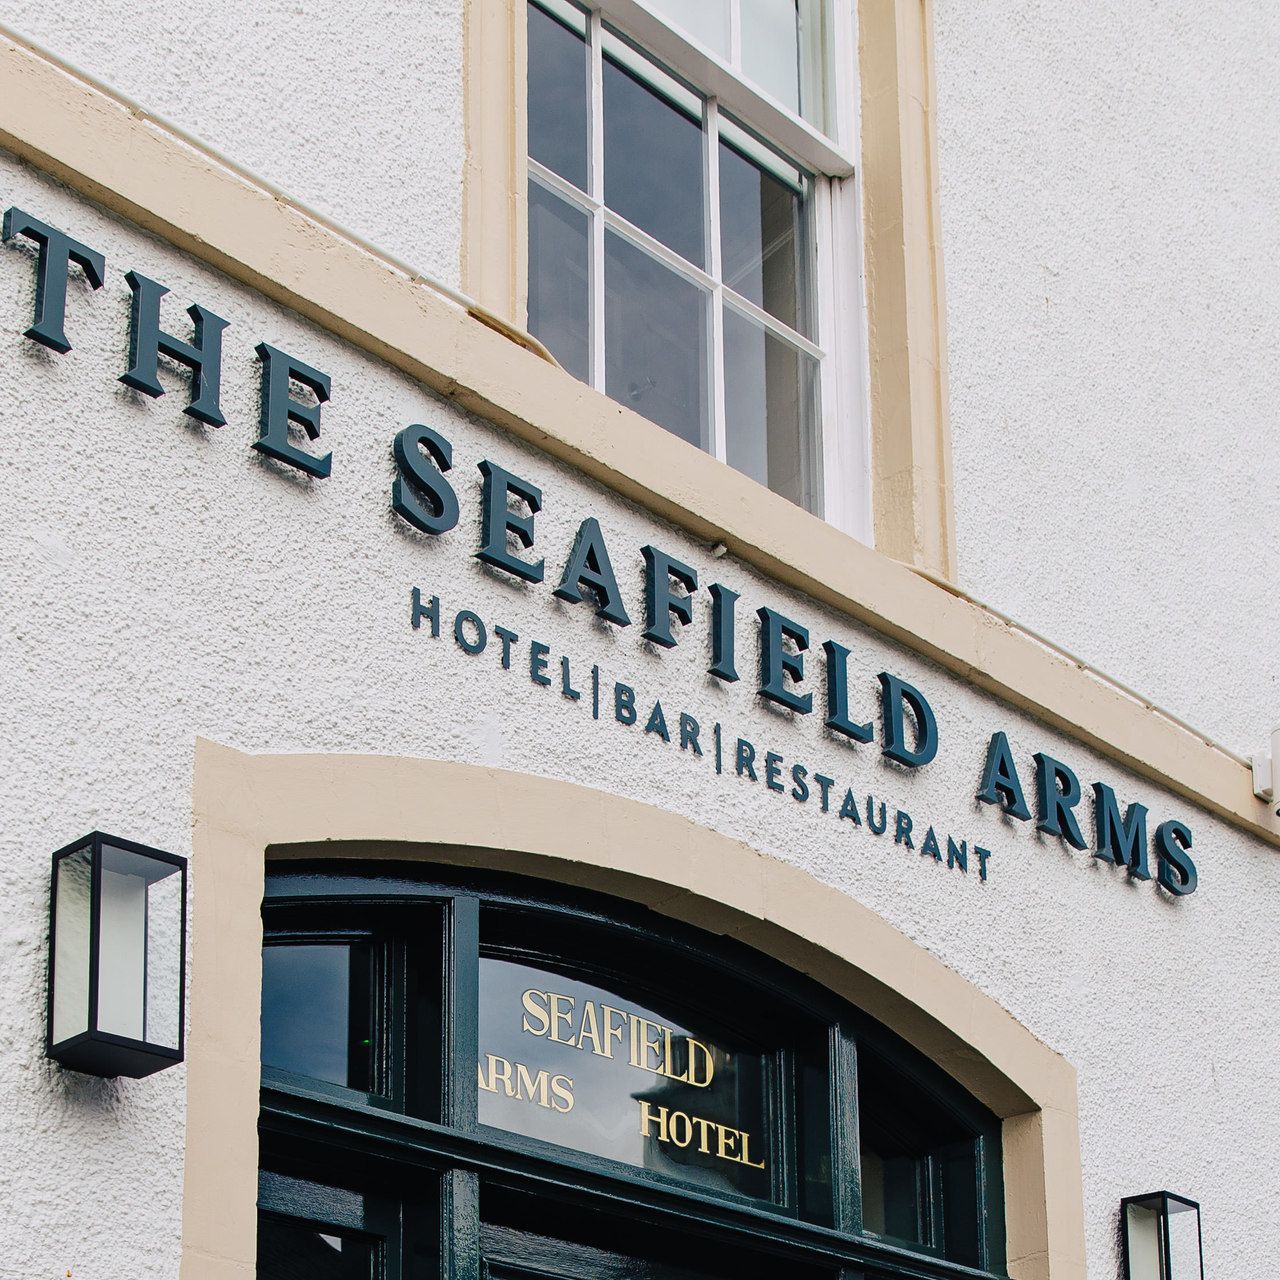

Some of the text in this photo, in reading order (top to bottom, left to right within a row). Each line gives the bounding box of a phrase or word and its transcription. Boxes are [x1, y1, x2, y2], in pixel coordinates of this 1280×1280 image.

[3, 206, 1198, 897] THE SEAFIELD ARMS
[411, 586, 992, 881] HOTEL BAR RESTAURANT
[521, 988, 715, 1088] SEAFIELD
[638, 1100, 765, 1169] HOTEL
